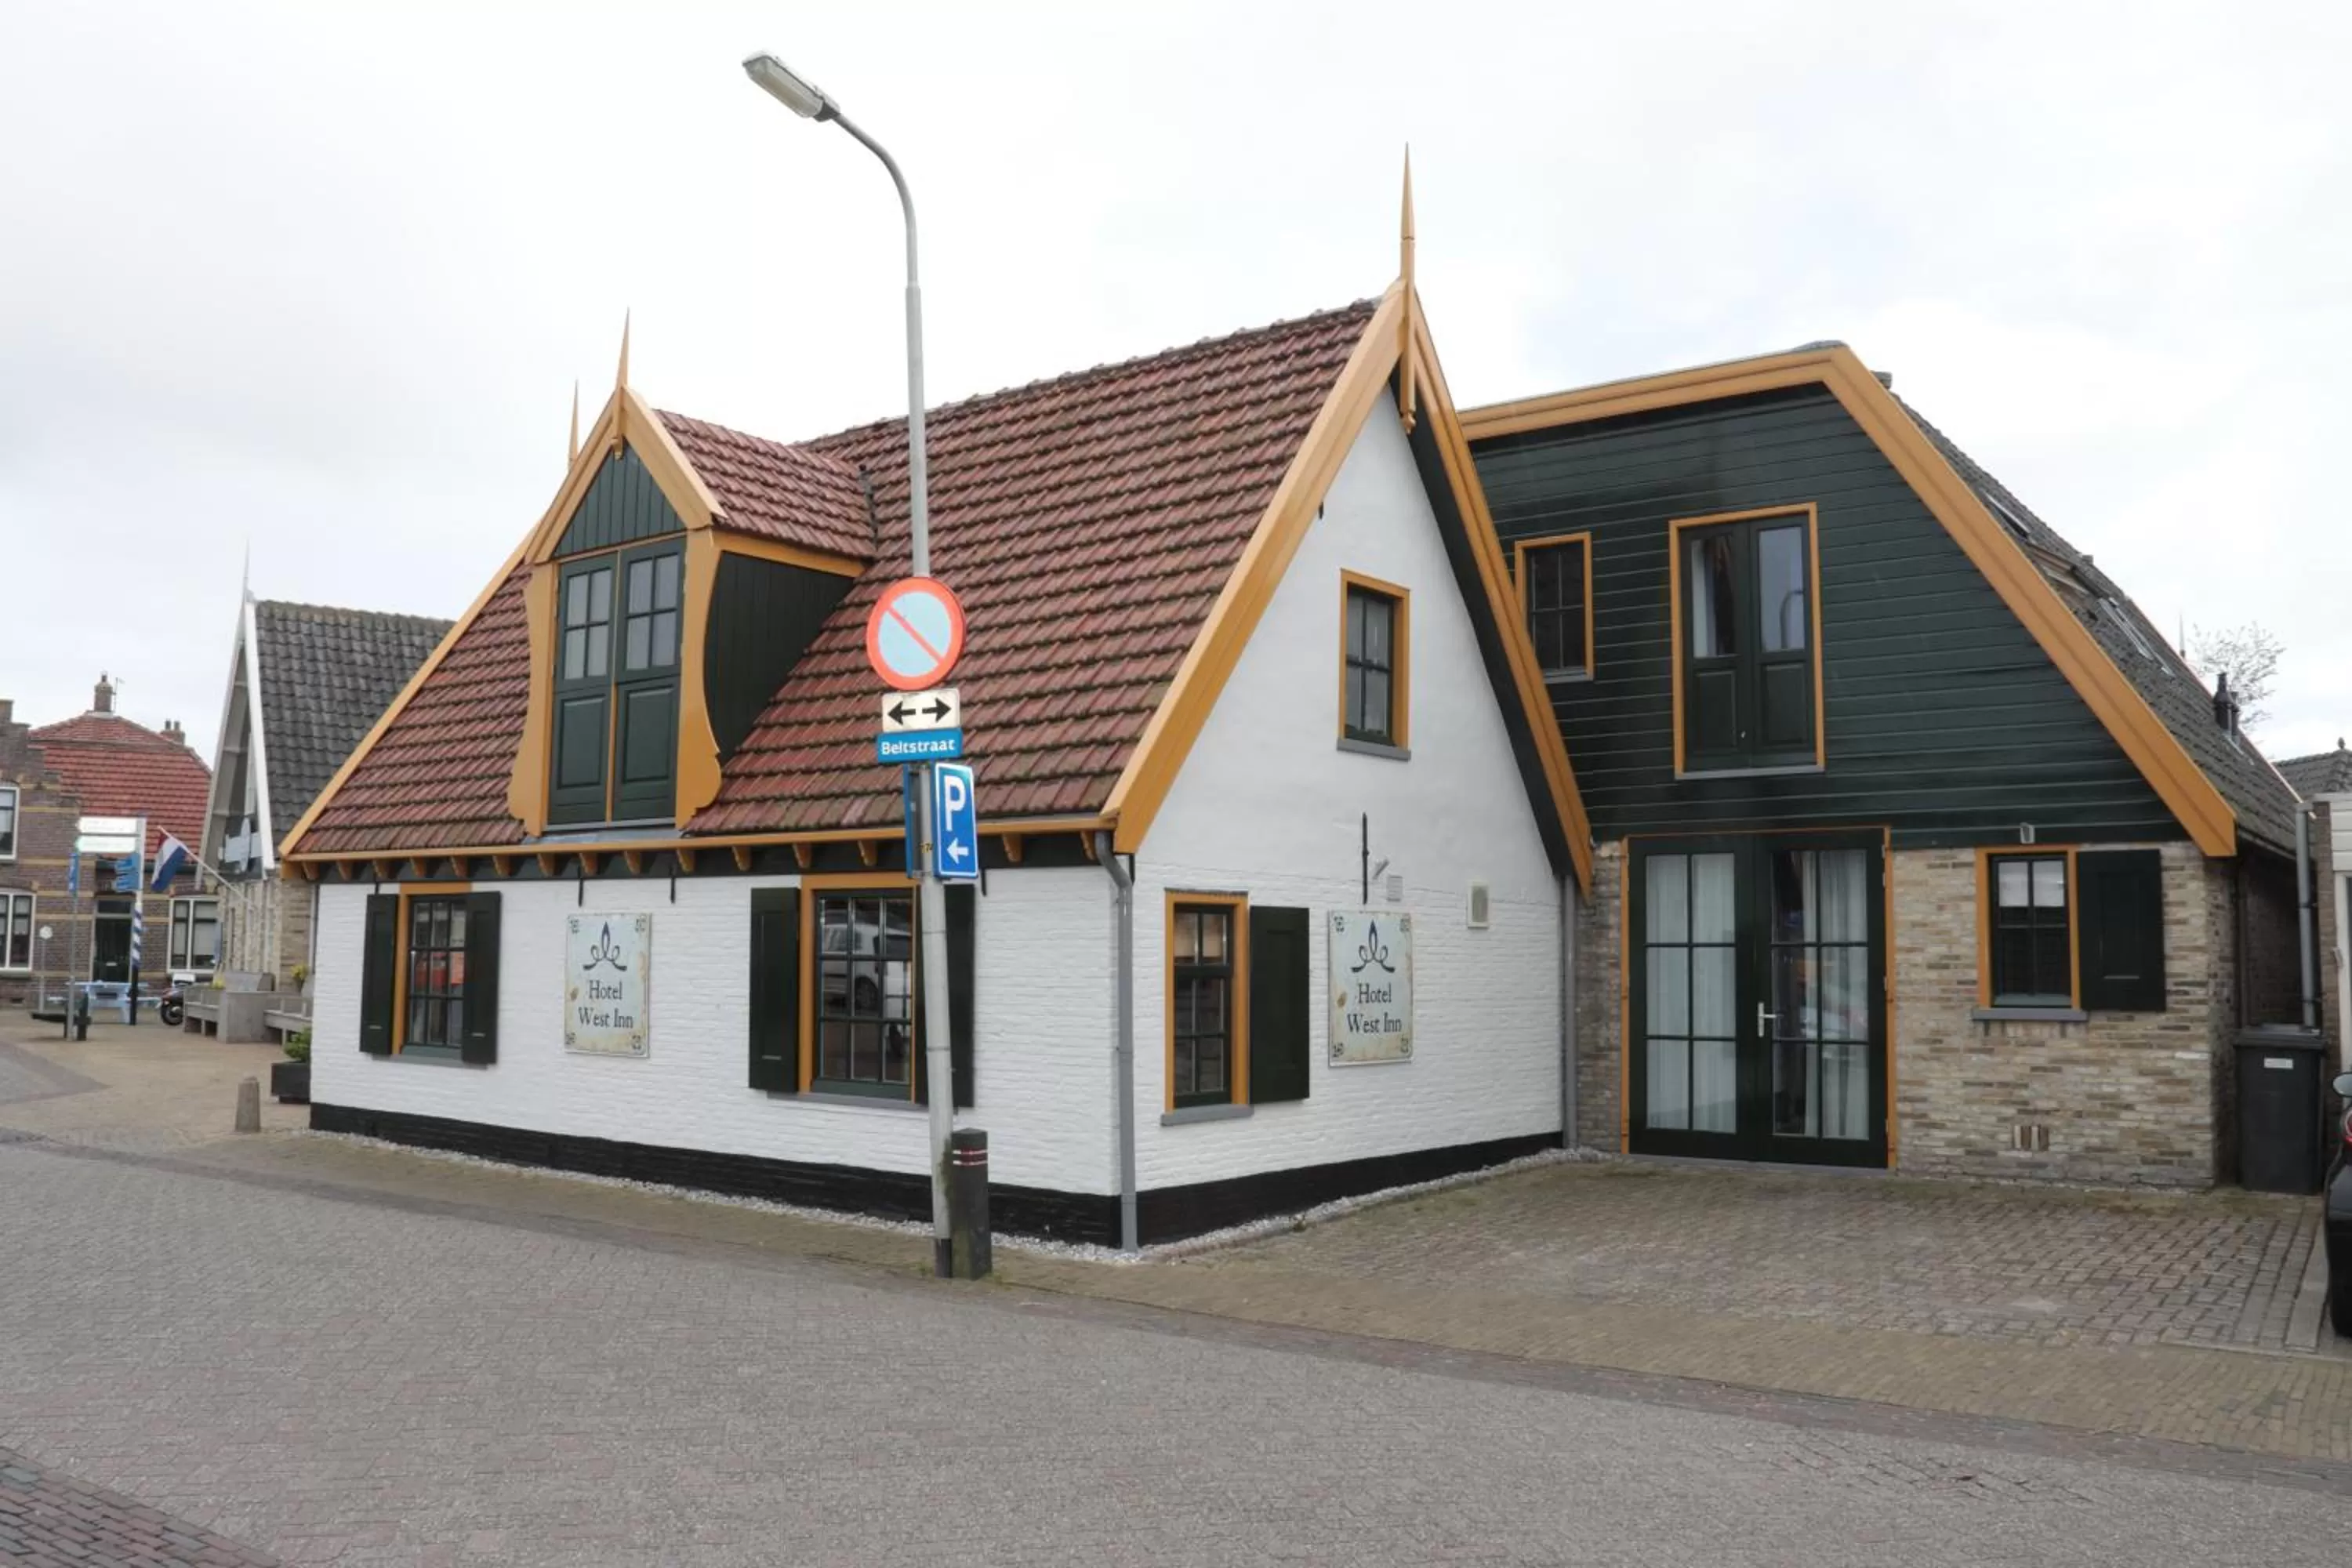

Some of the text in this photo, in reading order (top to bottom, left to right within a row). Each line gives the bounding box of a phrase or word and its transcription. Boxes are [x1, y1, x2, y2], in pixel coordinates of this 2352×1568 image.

[880, 739, 956, 755] Beltstraat
[944, 775, 965, 831] P
[589, 980, 622, 1000] Hotel
[1358, 982, 1392, 1004] Hotel
[579, 1007, 633, 1029] West Inn
[1347, 1012, 1402, 1033] West Inn
